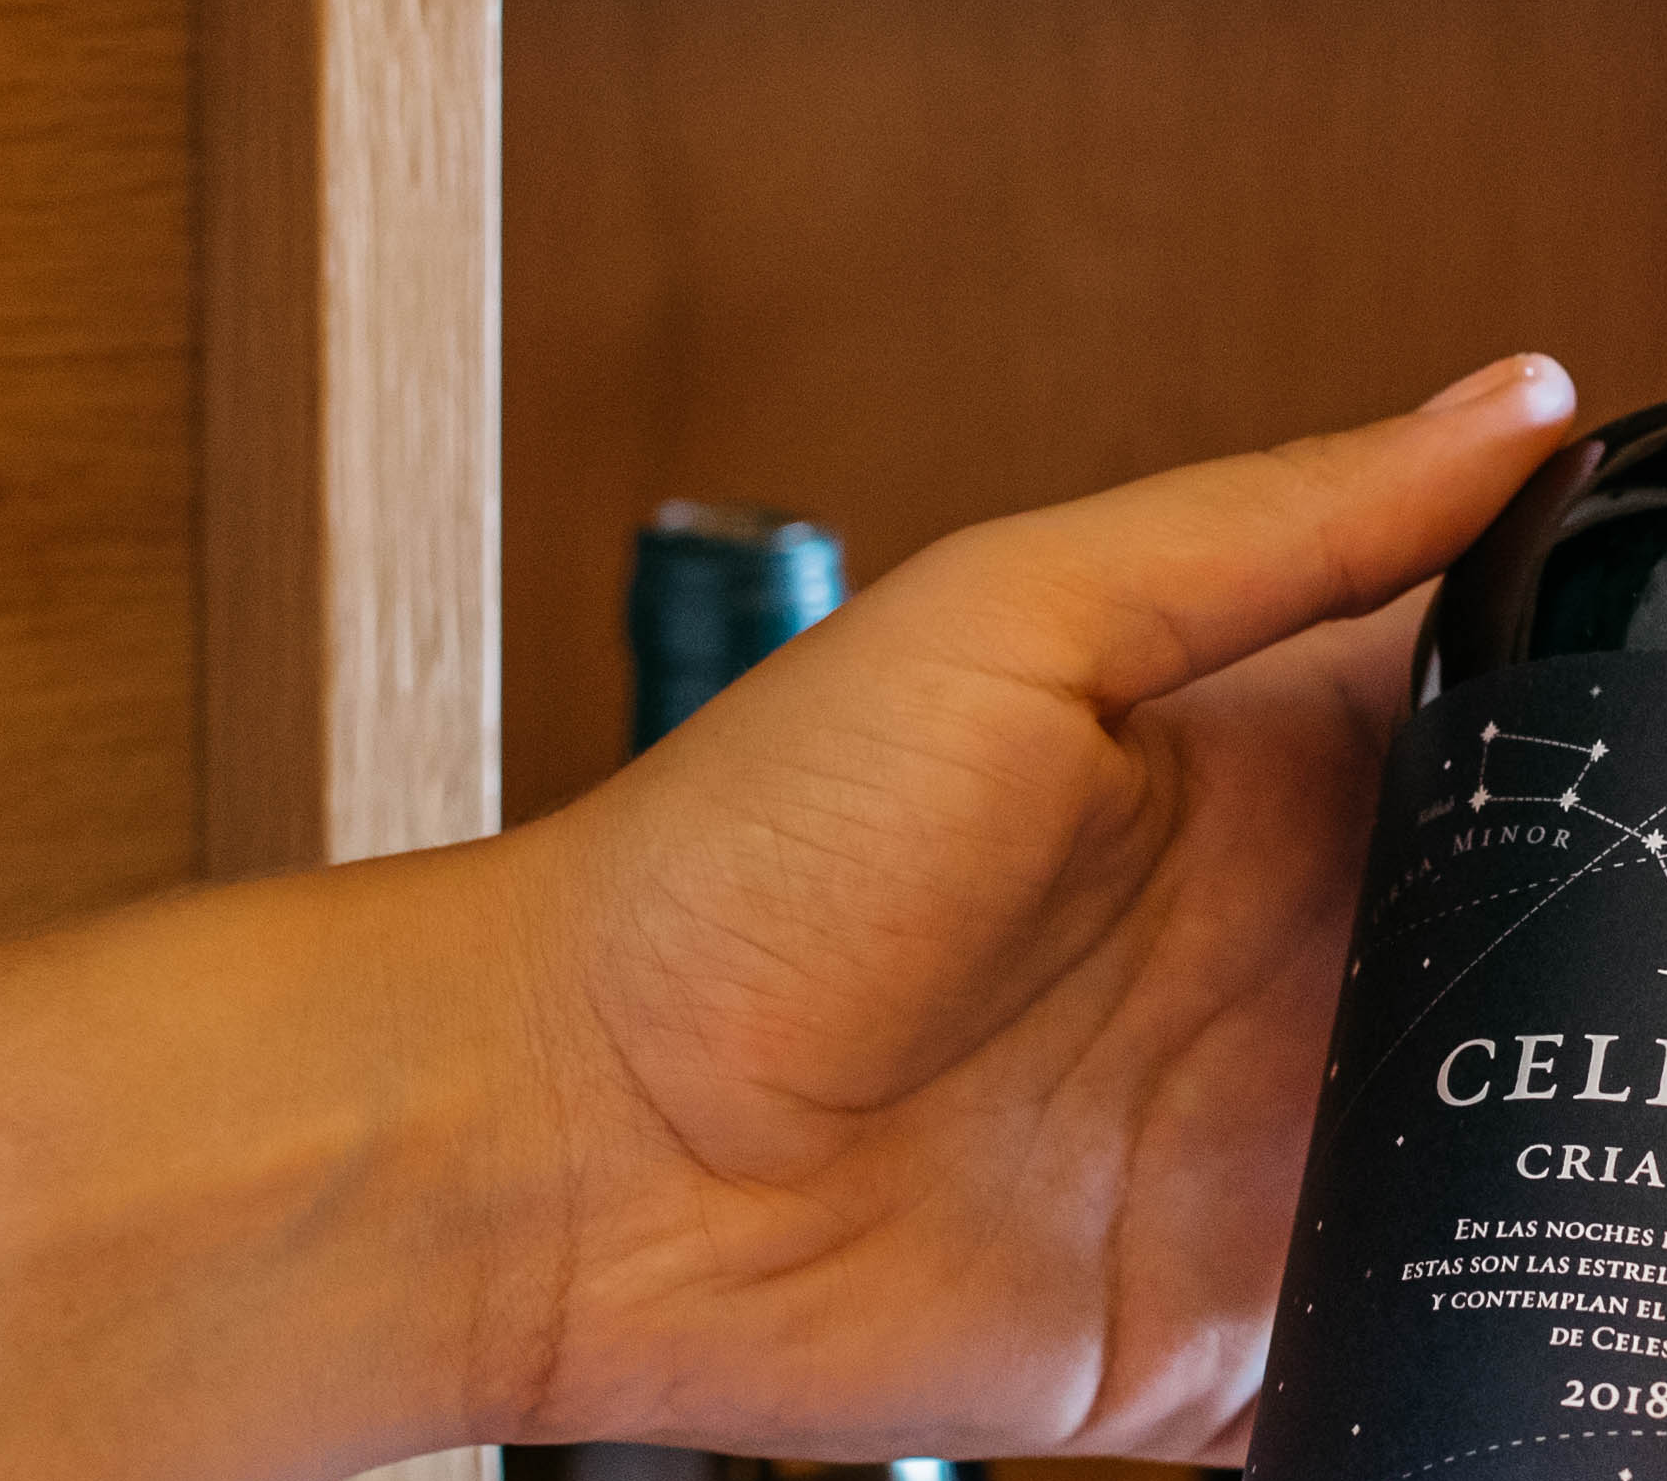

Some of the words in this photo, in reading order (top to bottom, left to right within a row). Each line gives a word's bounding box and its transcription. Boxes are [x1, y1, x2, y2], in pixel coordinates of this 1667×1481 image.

[1452, 825, 1571, 856] MINOR
[1496, 1220, 1538, 1239] LAS
[1545, 1221, 1654, 1247] NOCHES
[1401, 1257, 1464, 1281] ESTAS
[1469, 1255, 1519, 1274] SON
[1525, 1256, 1570, 1275] LAS
[1431, 1292, 1447, 1311] Y
[1451, 1290, 1629, 1316] CONTEMPLAN
[1636, 1299, 1666, 1321] EL
[1549, 1326, 1584, 1347] DE
